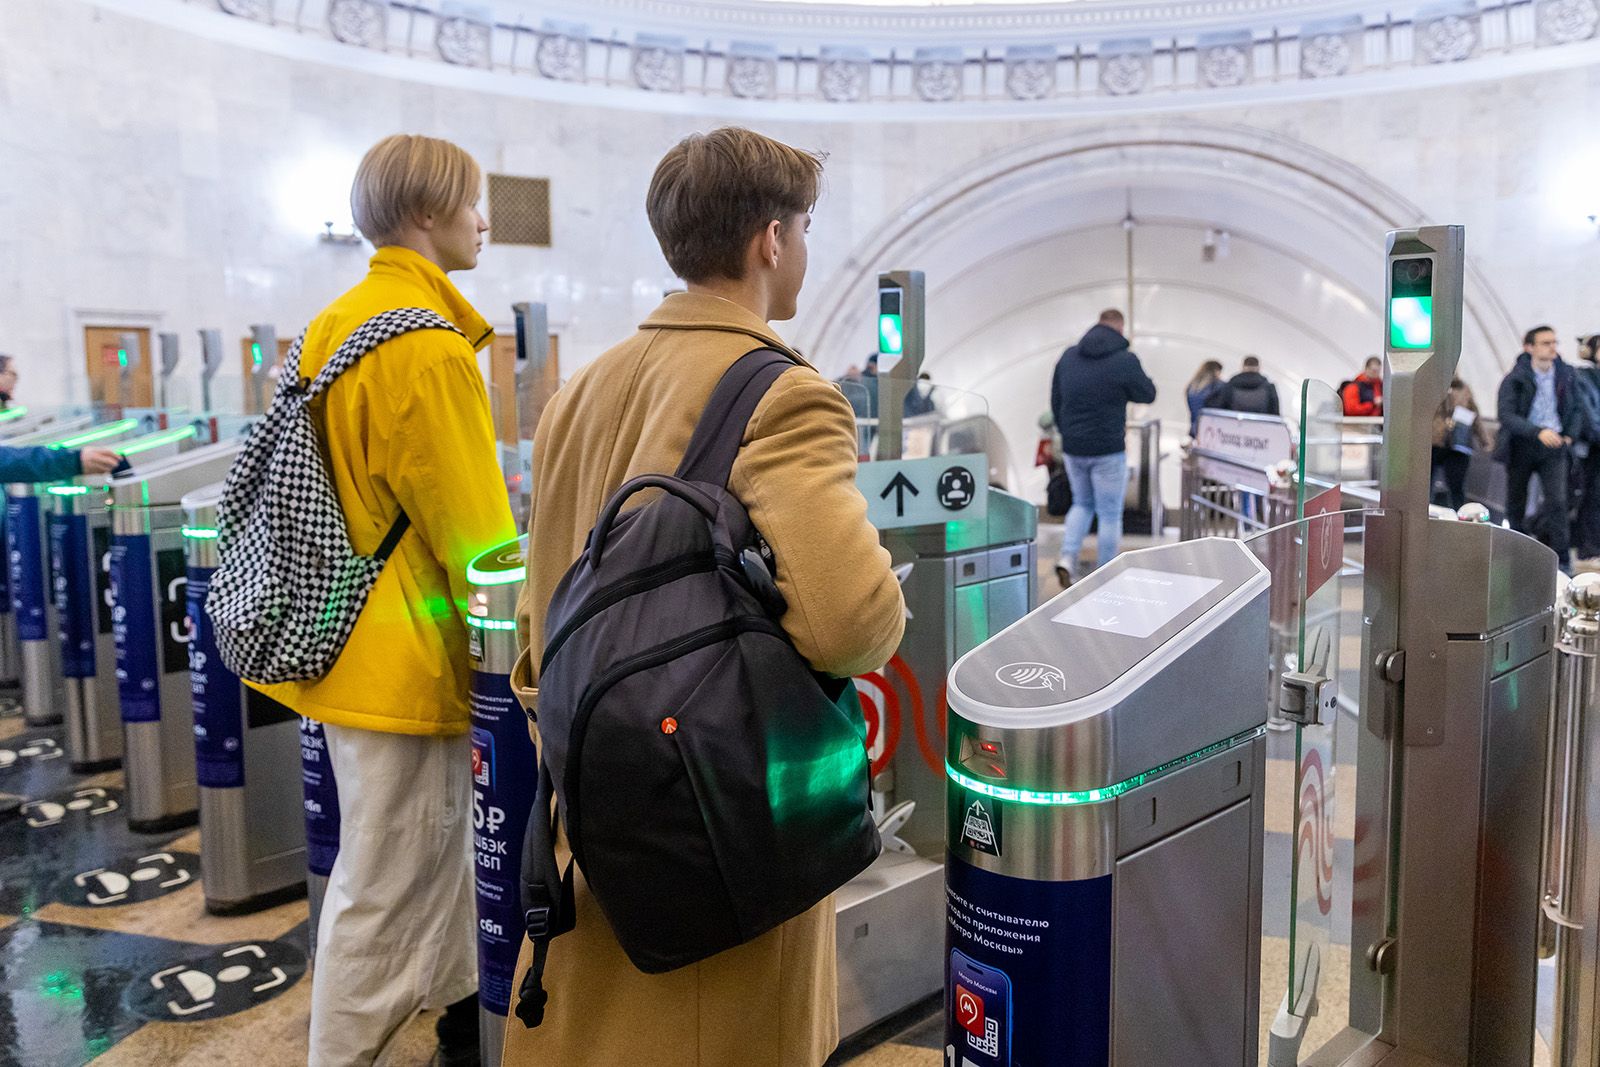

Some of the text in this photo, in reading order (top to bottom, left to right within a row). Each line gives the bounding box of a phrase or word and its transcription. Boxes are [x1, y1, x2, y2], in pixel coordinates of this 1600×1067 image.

[480, 918, 503, 935] сбп
[969, 903, 975, 911] к
[976, 906, 1049, 928] считывателю
[962, 913, 971, 924] из
[972, 919, 1041, 943] приложения
[973, 932, 1023, 955] Москвы»
[974, 980, 998, 995] Москвы
